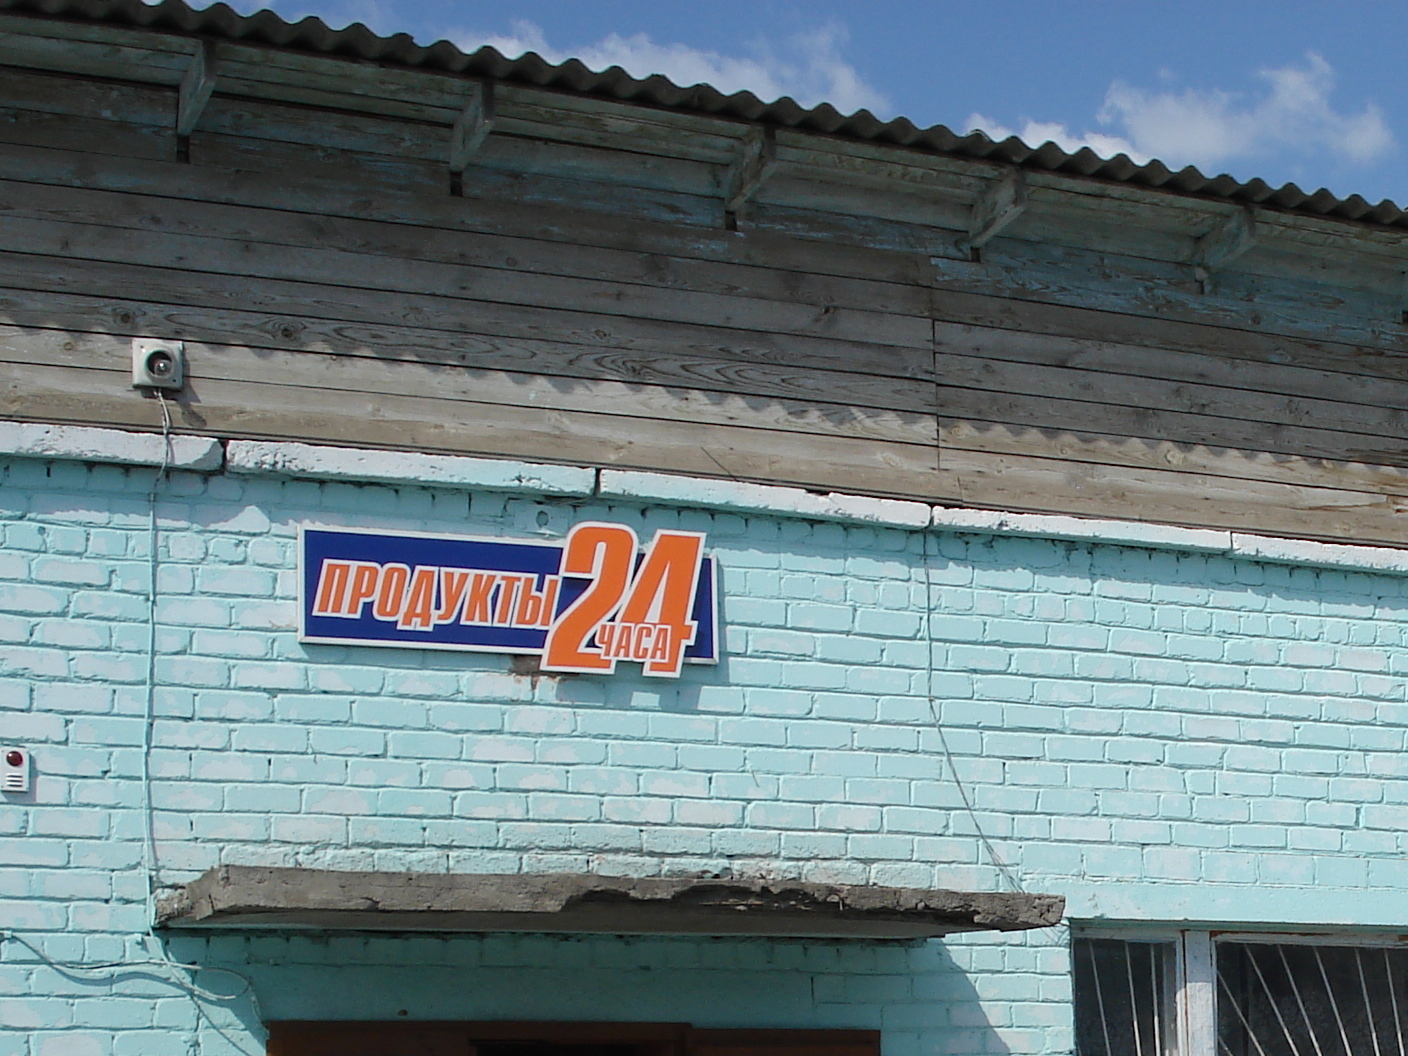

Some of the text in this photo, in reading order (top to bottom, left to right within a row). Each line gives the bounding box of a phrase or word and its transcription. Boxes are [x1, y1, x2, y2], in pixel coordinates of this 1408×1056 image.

[312, 521, 707, 679] ПРОДУКТЫ 24
[595, 622, 671, 664] ЧАСА
